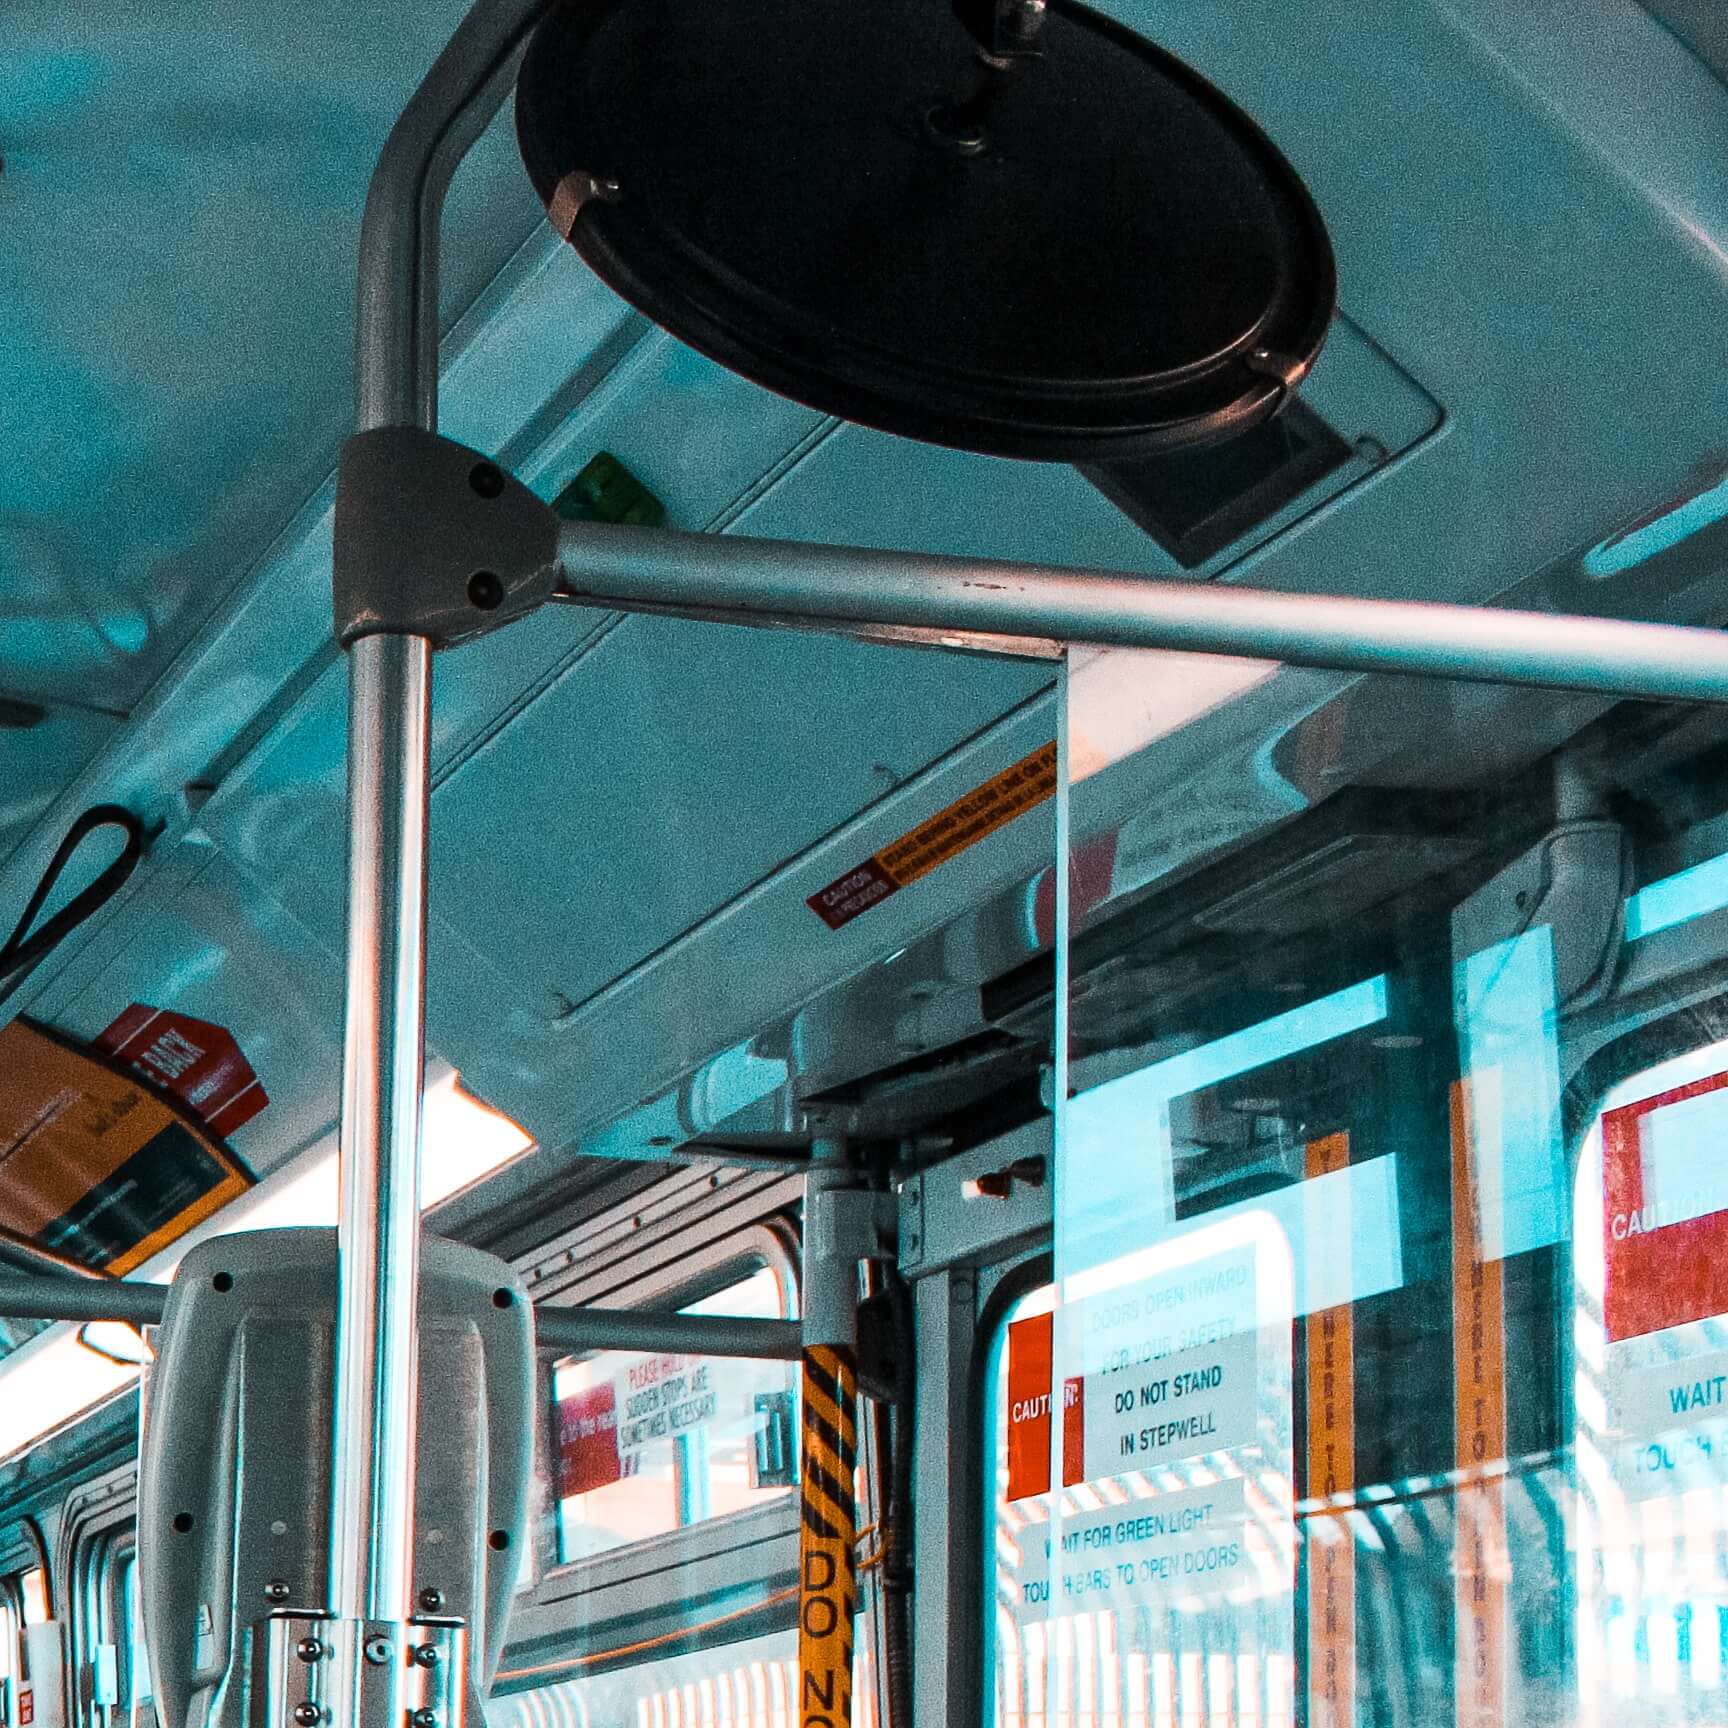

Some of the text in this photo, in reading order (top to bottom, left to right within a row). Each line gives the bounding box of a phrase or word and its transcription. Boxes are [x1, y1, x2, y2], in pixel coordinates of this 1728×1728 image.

[1013, 1383, 1080, 1424] CAUTIN:
[1115, 1364, 1222, 1414] DO NOT STAND
[1669, 1376, 1726, 1415] WAIT
[1121, 1412, 1216, 1455] IN STEPWELL
[1045, 1504, 1214, 1560] AIT FOR GREEN LIGHT
[804, 1551, 836, 1639] DO
[1023, 1574, 1072, 1603] TOUH
[1116, 1563, 1134, 1585] TO
[1139, 1554, 1179, 1582] OPEN
[1184, 1543, 1239, 1575] DOORS
